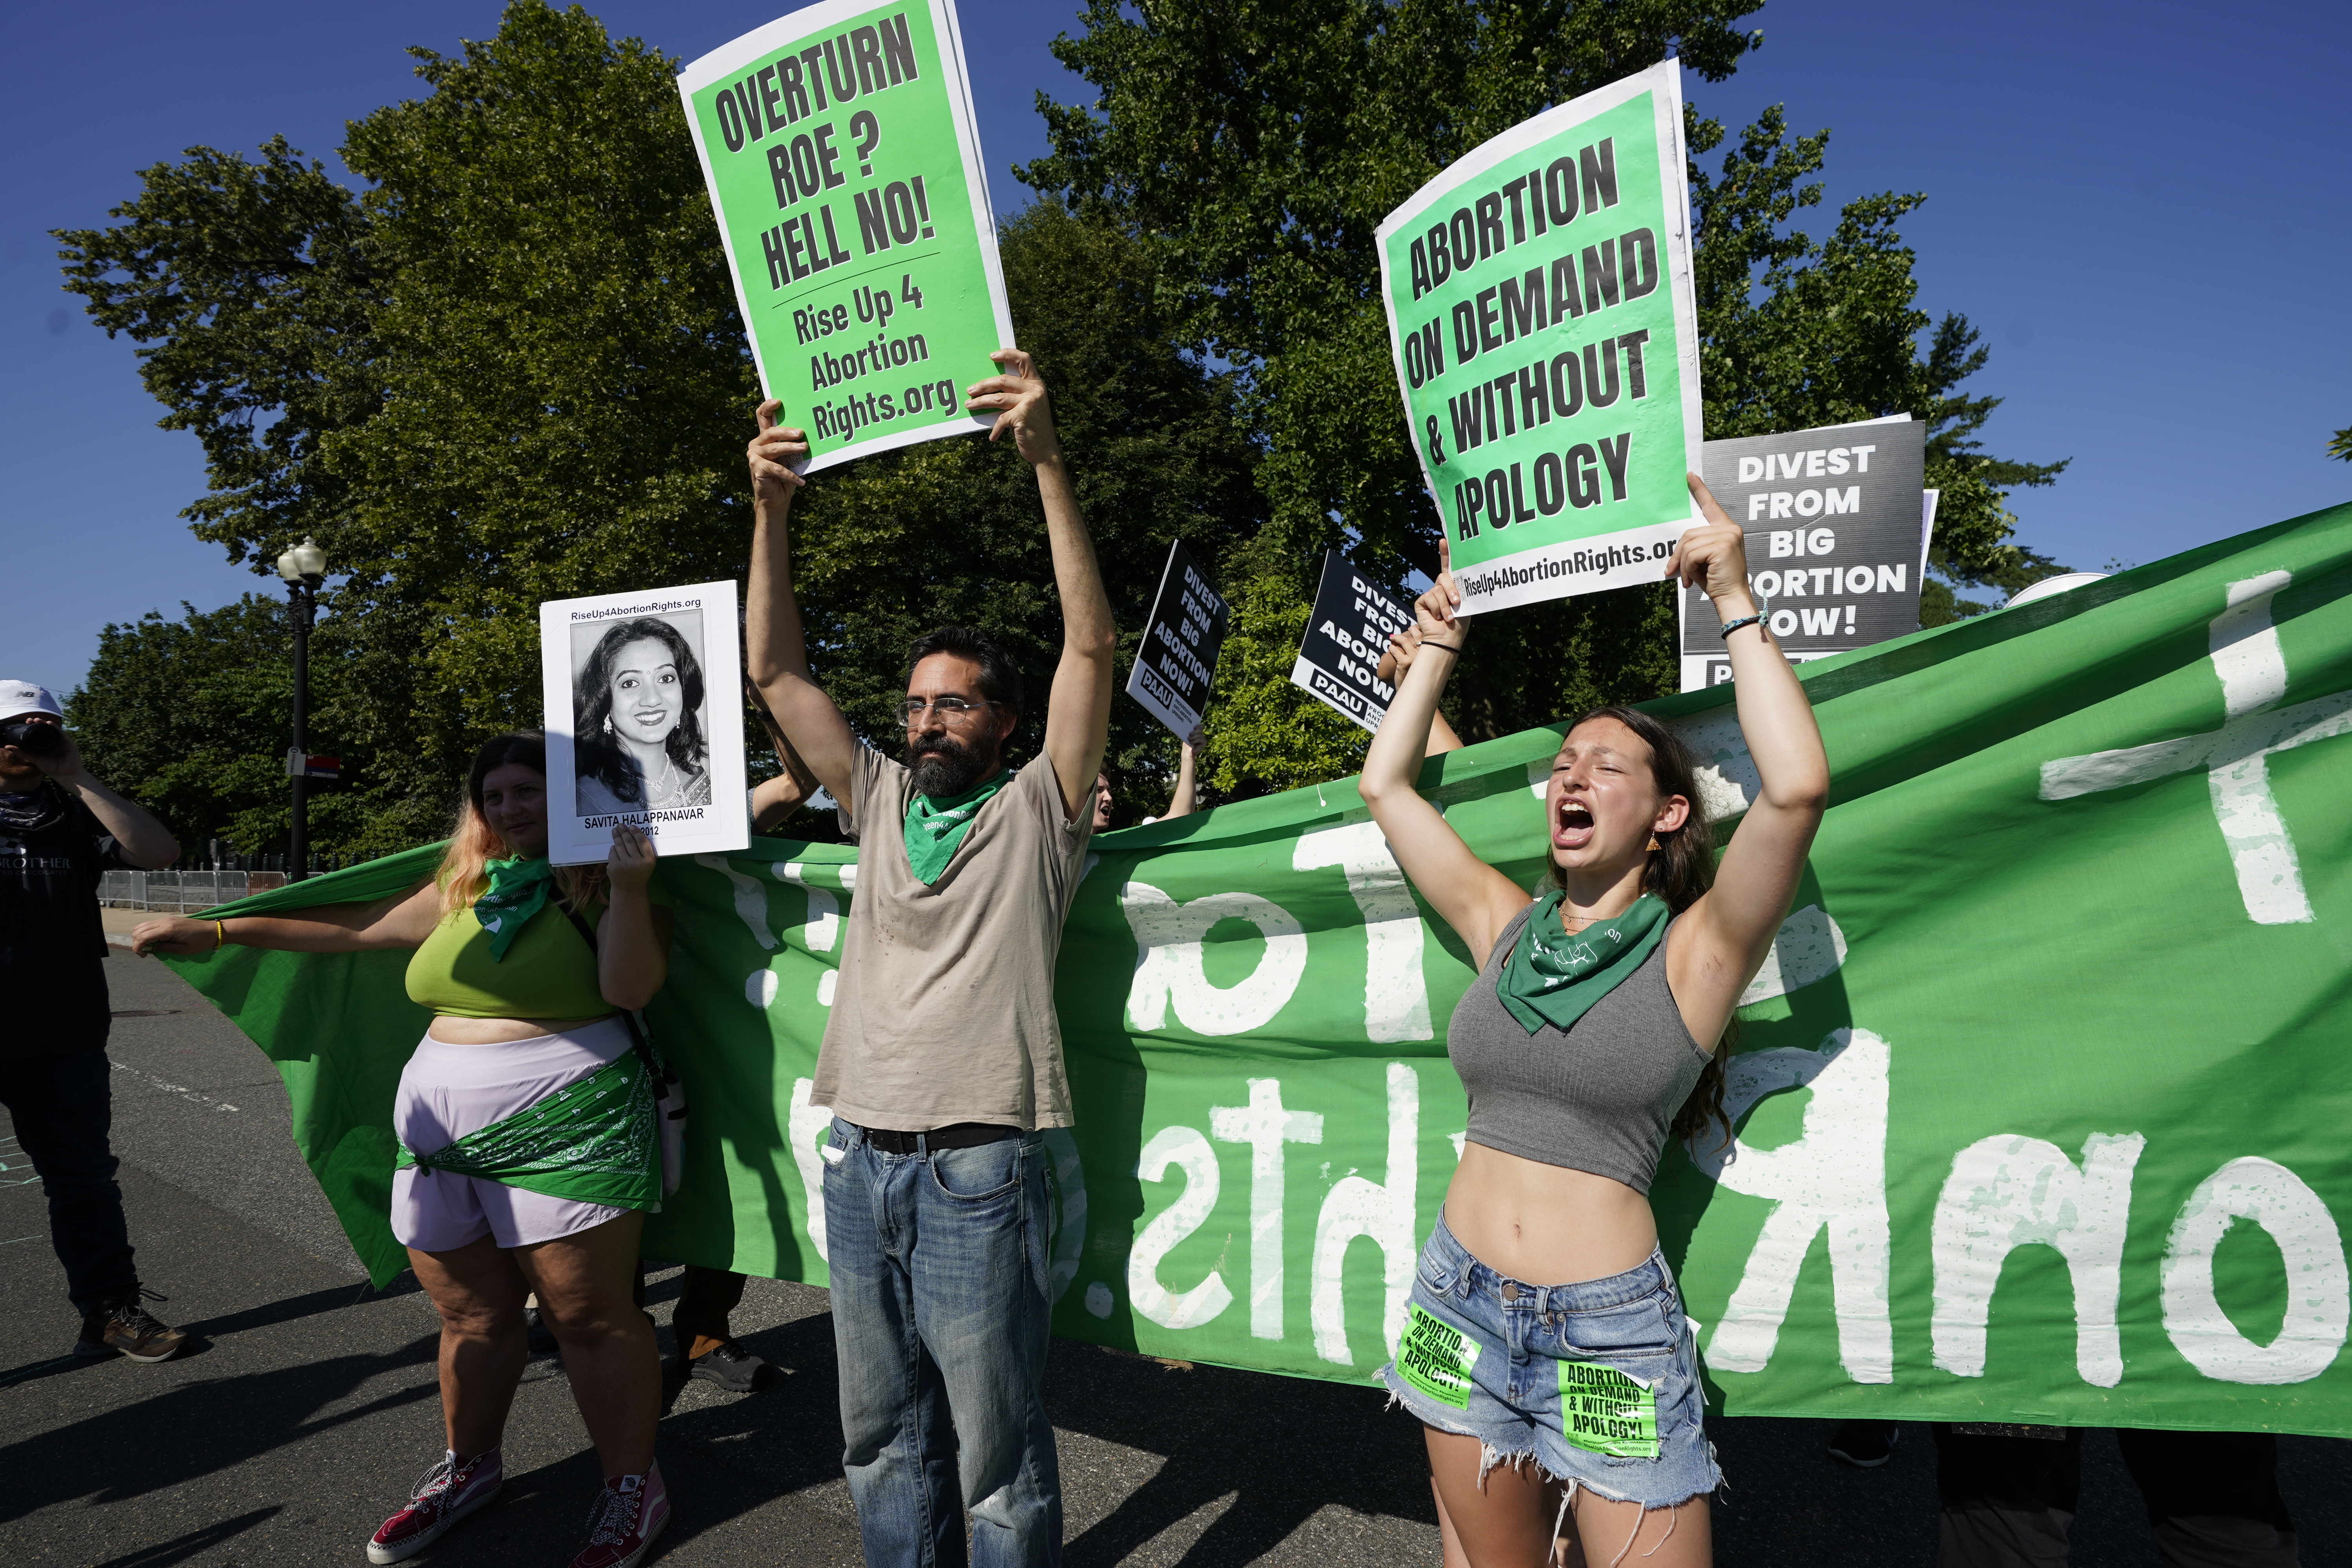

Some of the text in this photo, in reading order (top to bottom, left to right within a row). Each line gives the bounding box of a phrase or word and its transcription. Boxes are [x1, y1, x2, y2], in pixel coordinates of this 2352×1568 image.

[716, 13, 919, 153] OVERTURN
[767, 110, 880, 210] ROE ?
[761, 176, 936, 291] HELL NO!
[1410, 136, 1619, 302] ABORTION
[793, 274, 924, 346] Rise Up 4
[1405, 227, 1659, 390] ON DEMAND
[811, 333, 929, 392] Abortion
[812, 379, 958, 442] Rights.org
[1426, 328, 1650, 466] & WITHOUT
[1739, 445, 1876, 483] DIVEST
[1455, 432, 1631, 542] APOLOGY
[1748, 486, 1860, 521] FROM
[1769, 528, 1835, 558] BIG
[1464, 539, 1681, 597] RiseUp4AbortionRights.or
[1700, 564, 1906, 601] ORTION
[1184, 564, 1220, 615] DIVEST
[571, 599, 701, 620] RiseUp4AbortionRights.org
[1181, 590, 1211, 634] FROM
[1762, 605, 1856, 637] OW!
[1180, 617, 1199, 646] BIG
[1319, 620, 1381, 670] ABOR
[1154, 621, 1210, 687] ABORTION
[1143, 671, 1172, 705] PAAU
[1160, 653, 1194, 696] NOW!
[1315, 674, 1362, 712] PAAU
[1338, 654, 1394, 702] NOW
[1172, 709, 1184, 722] UPRISING
[1173, 704, 1192, 724] ANTI-ABORTION
[1175, 698, 1192, 717] PROGRESSIVE
[584, 808, 704, 829] SAVITA HALAPPANAVAR
[641, 826, 659, 836] 2012
[0, 858, 71, 868] ROTHER
[1406, 1336, 1460, 1374] & WITHO
[1412, 1326, 1461, 1369] ON DEMAND
[1408, 1376, 1463, 1405] RiseUp4AbortionRights.org
[1569, 1396, 1577, 1410] &
[1570, 1385, 1640, 1403] ON DEMAND
[1573, 1414, 1643, 1439] APOLOGY!
[1584, 1443, 1651, 1452] RiseUp4AboionRights.org
